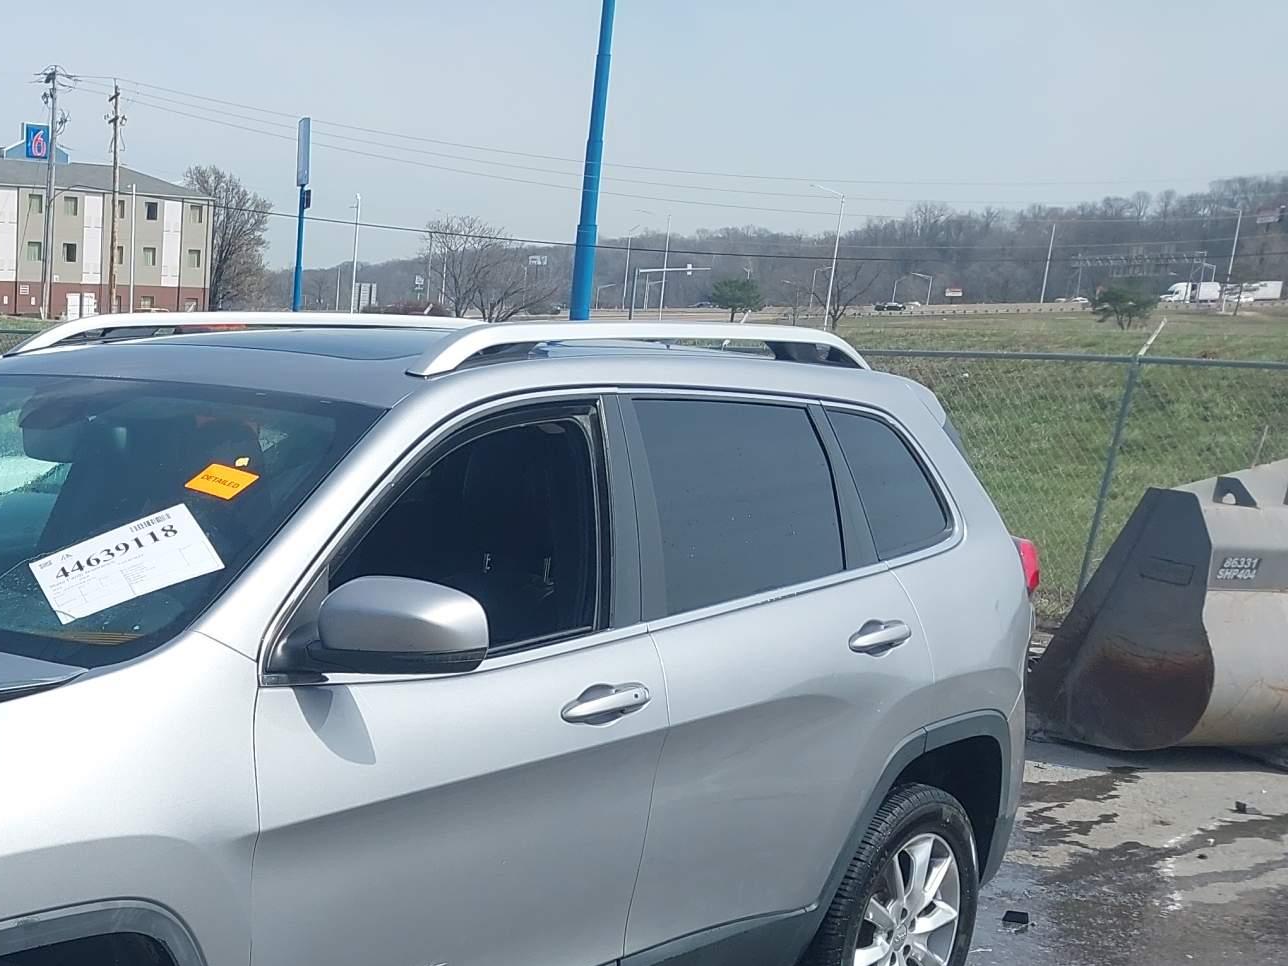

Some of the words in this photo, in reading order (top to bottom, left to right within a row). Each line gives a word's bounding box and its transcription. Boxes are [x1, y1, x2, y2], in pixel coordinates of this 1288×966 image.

[32, 129, 47, 157] 6
[200, 474, 240, 489] DETAILED
[55, 524, 178, 580] 44639118
[1223, 557, 1259, 569] 86331
